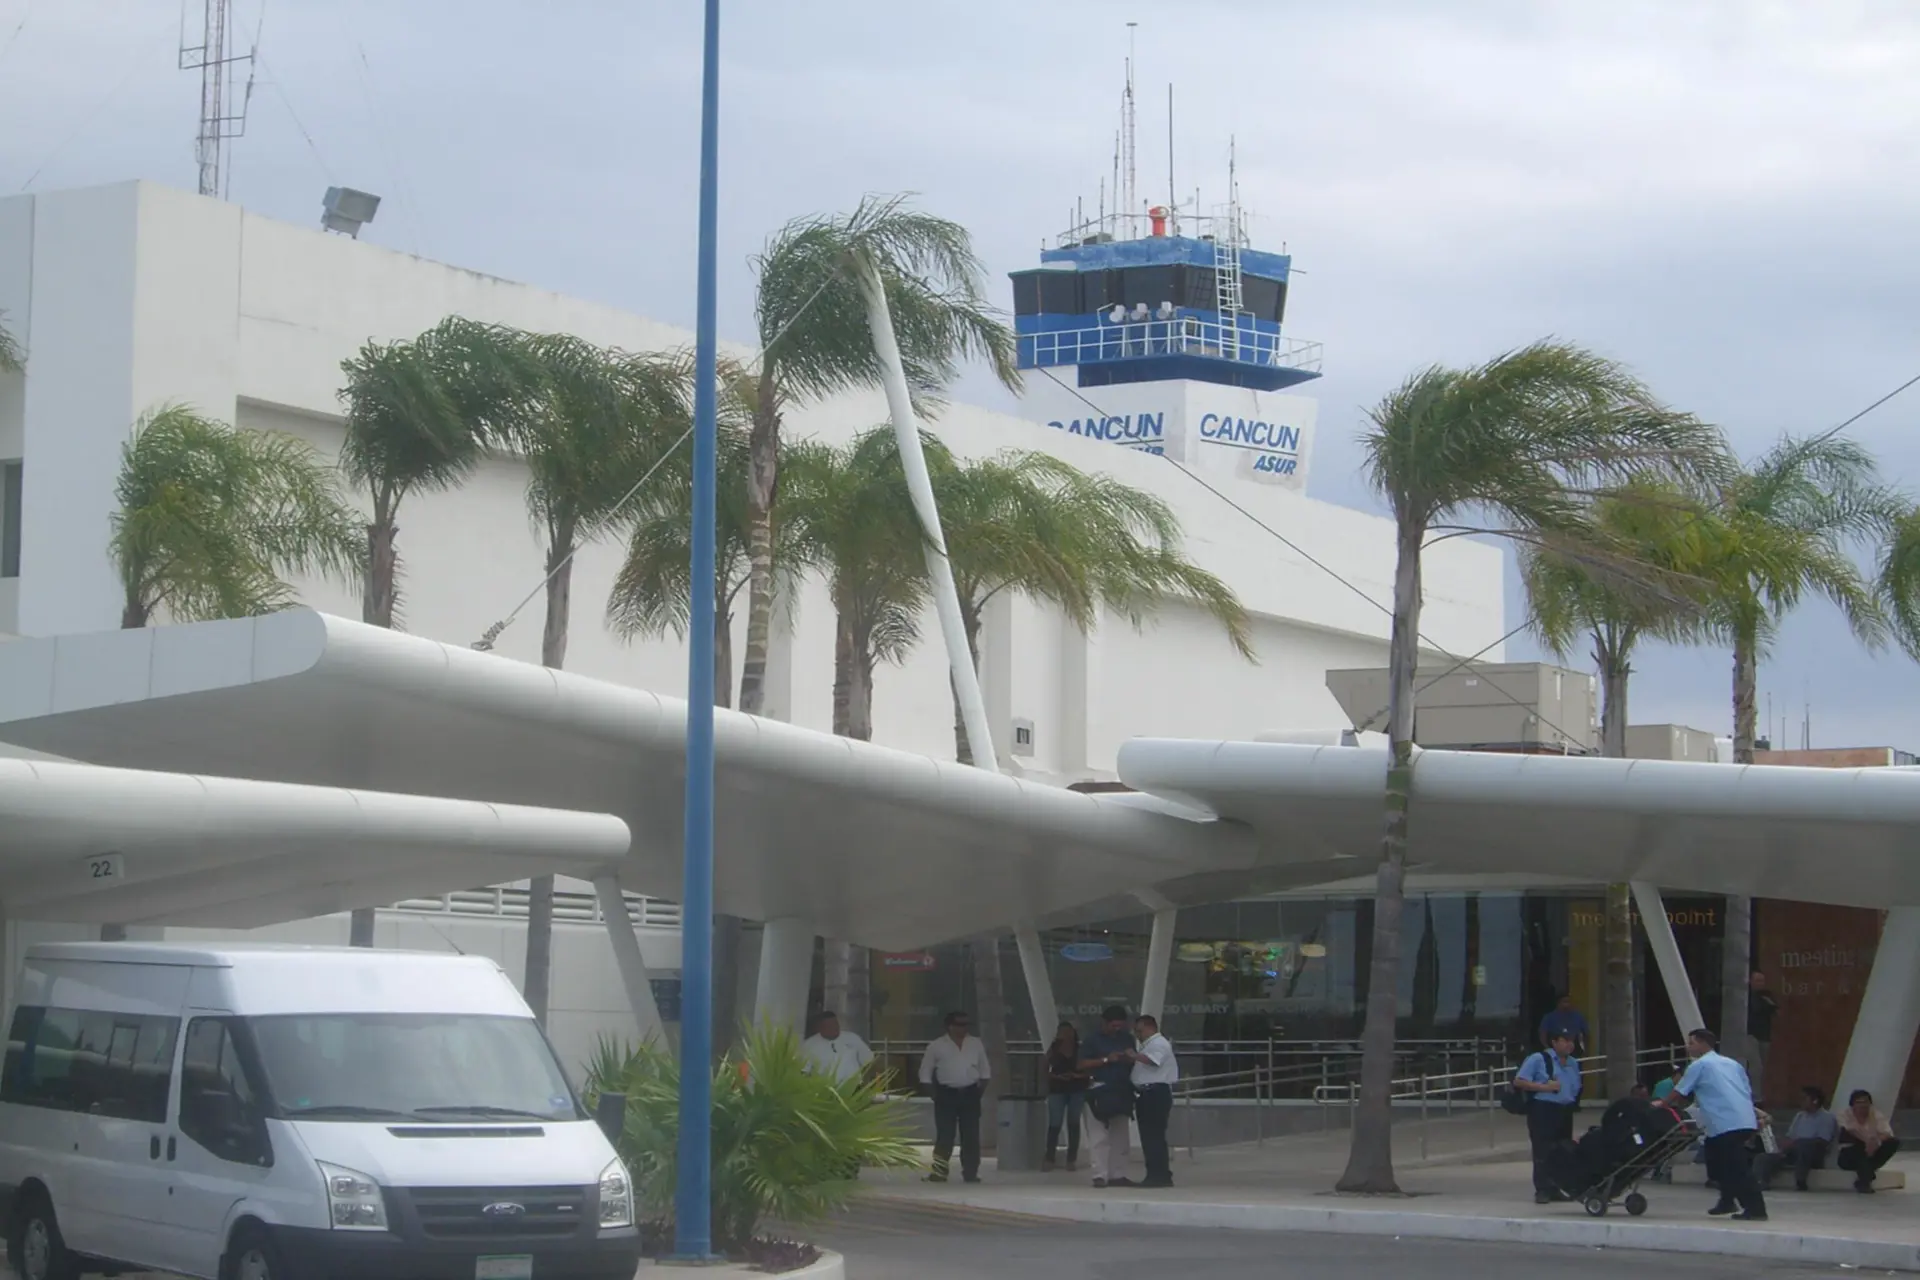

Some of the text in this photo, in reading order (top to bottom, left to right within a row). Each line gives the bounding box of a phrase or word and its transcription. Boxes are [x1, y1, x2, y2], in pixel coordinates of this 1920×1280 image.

[1047, 412, 1164, 440] ANCUN
[1200, 413, 1300, 450] CANCUN
[1253, 455, 1298, 475] ASUR
[91, 860, 113, 878] 22
